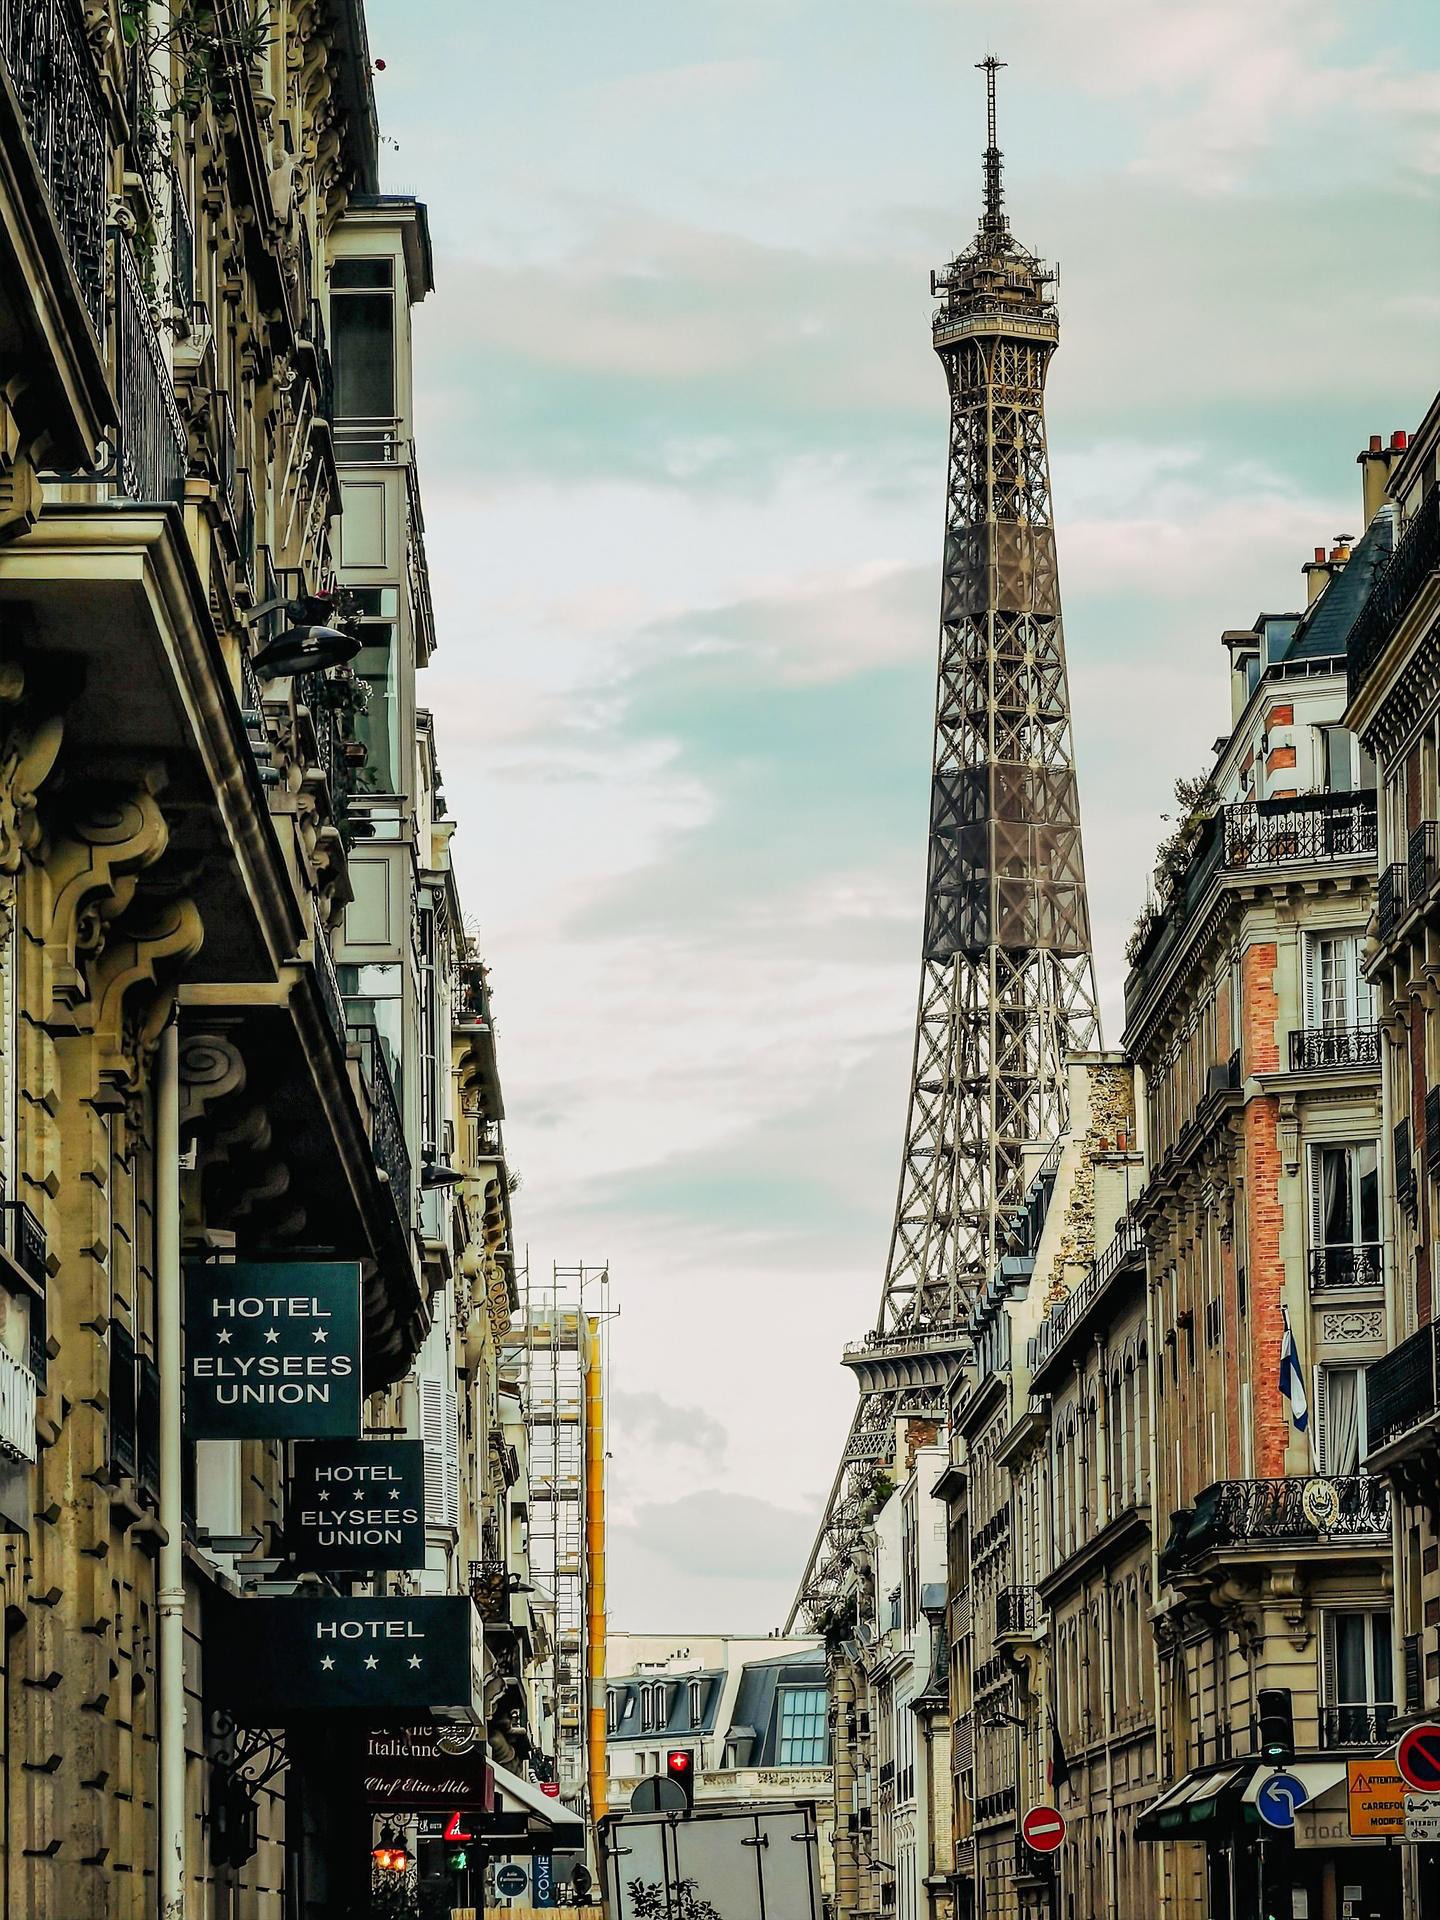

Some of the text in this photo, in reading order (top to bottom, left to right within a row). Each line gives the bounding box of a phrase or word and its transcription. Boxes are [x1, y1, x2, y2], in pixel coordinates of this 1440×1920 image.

[212, 1297, 332, 1318] HOTEL
[193, 1356, 352, 1377] ELYSEES
[216, 1383, 330, 1404] UNION
[315, 1466, 403, 1482] HOTEL
[301, 1509, 418, 1526] ELYSEES
[318, 1530, 402, 1546] UNION
[316, 1620, 425, 1639] HOTEL
[368, 1739, 441, 1757] Italienne
[364, 1777, 401, 1797] Chef
[1368, 1776, 1404, 1784] ATTENTION
